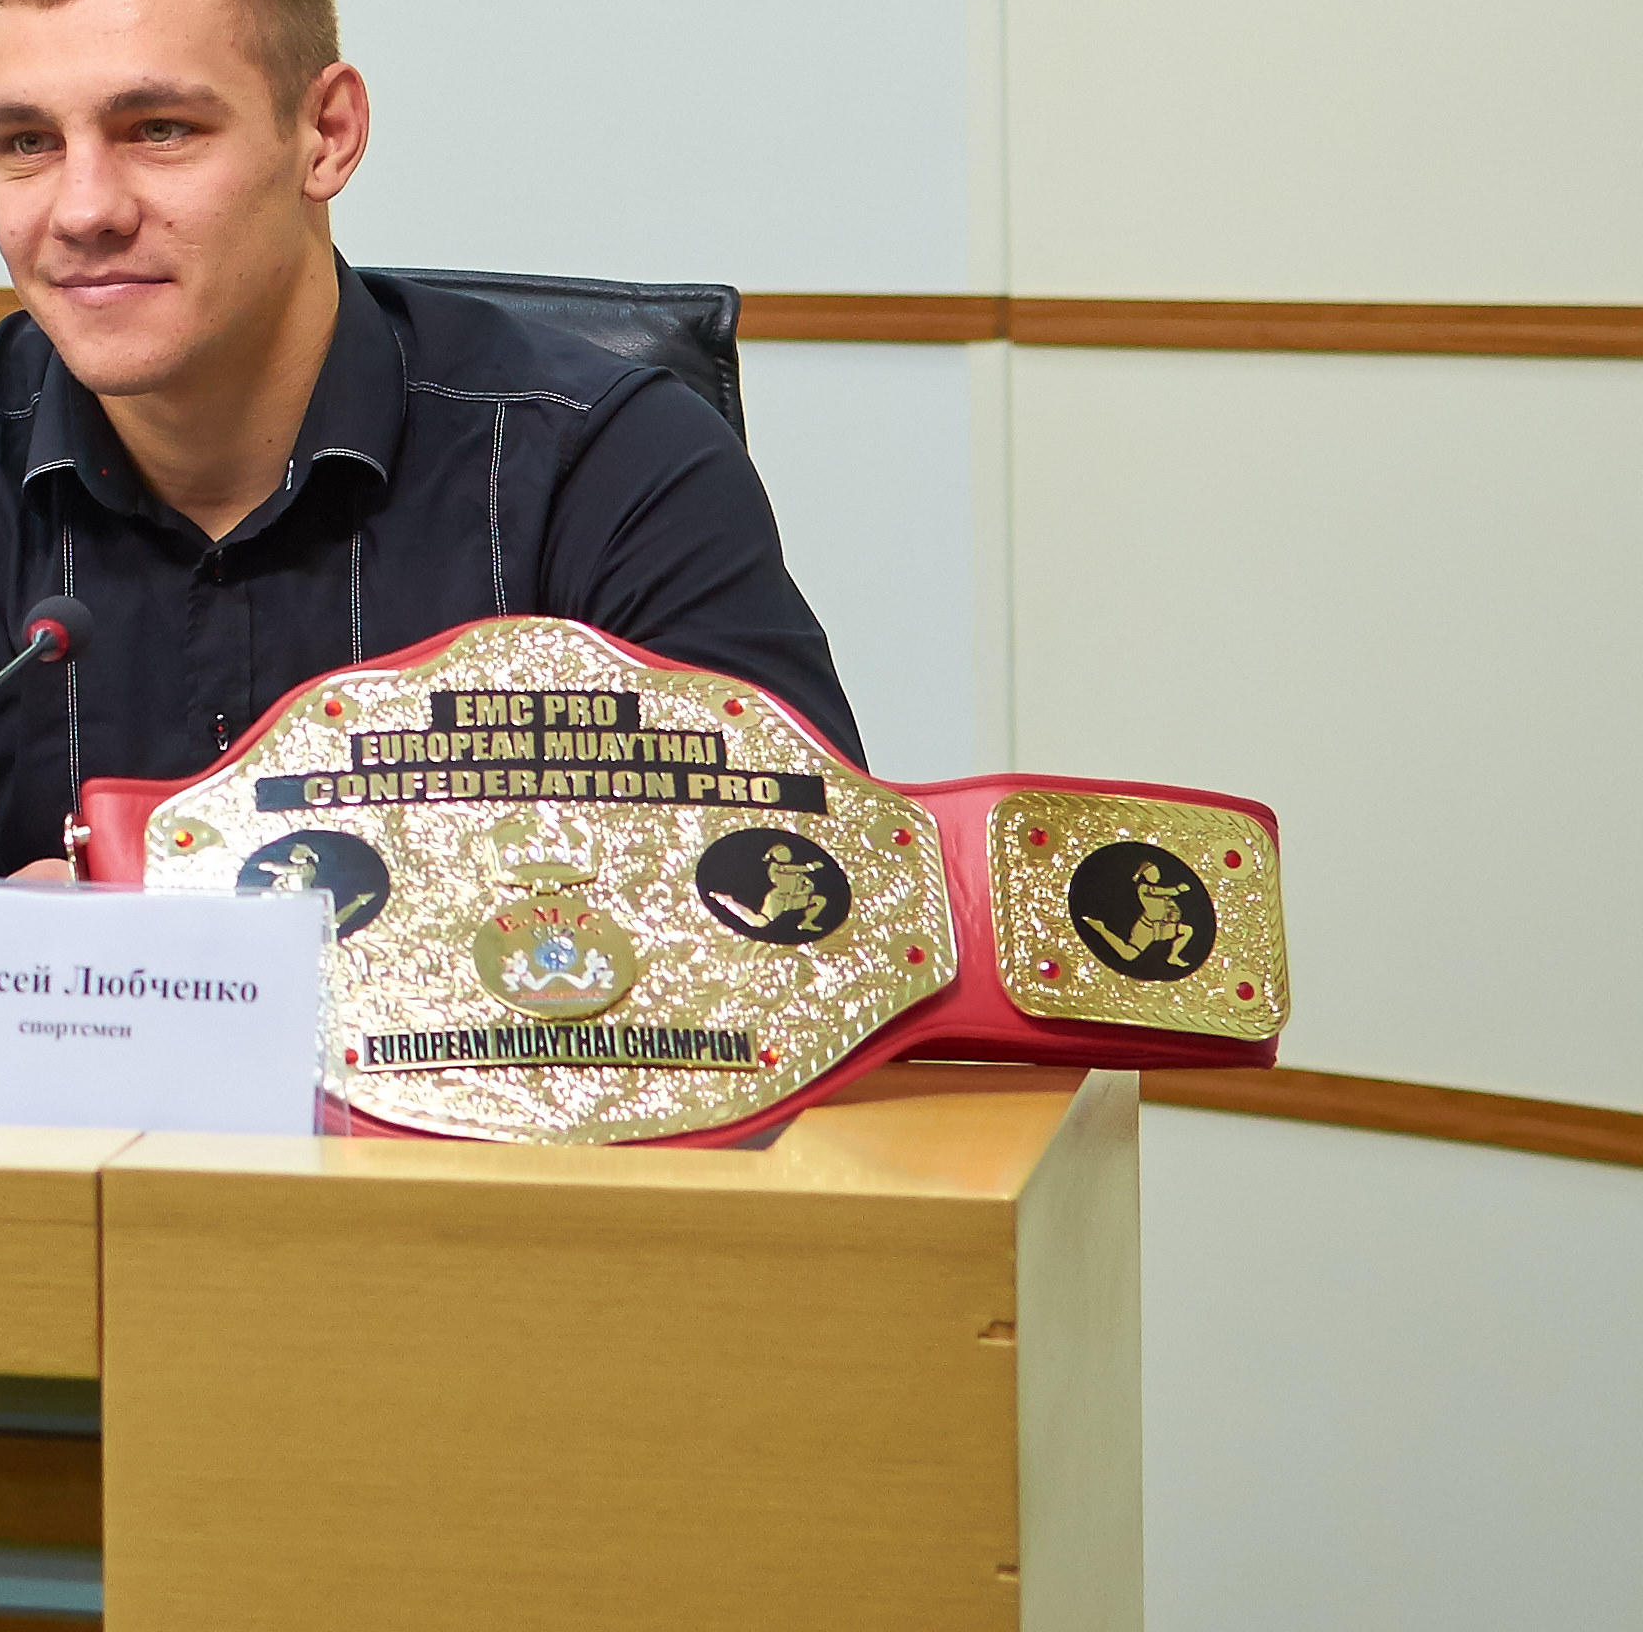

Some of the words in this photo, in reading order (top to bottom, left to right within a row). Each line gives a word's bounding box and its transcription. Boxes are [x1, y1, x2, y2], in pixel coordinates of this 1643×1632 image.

[453, 694, 535, 728] EMC
[542, 696, 618, 728] PRO
[358, 731, 536, 766] EUROPEAN
[542, 731, 718, 765] MUAYTHAI
[302, 770, 677, 805] CONFEDERATION
[686, 774, 781, 805] PRO
[63, 966, 260, 1004] Любченко
[18, 1018, 132, 1041] спортсмен
[368, 1027, 490, 1065] EUROPEAN
[495, 1024, 616, 1060] MUAYTHAI
[623, 1024, 752, 1063] CHAMPION
